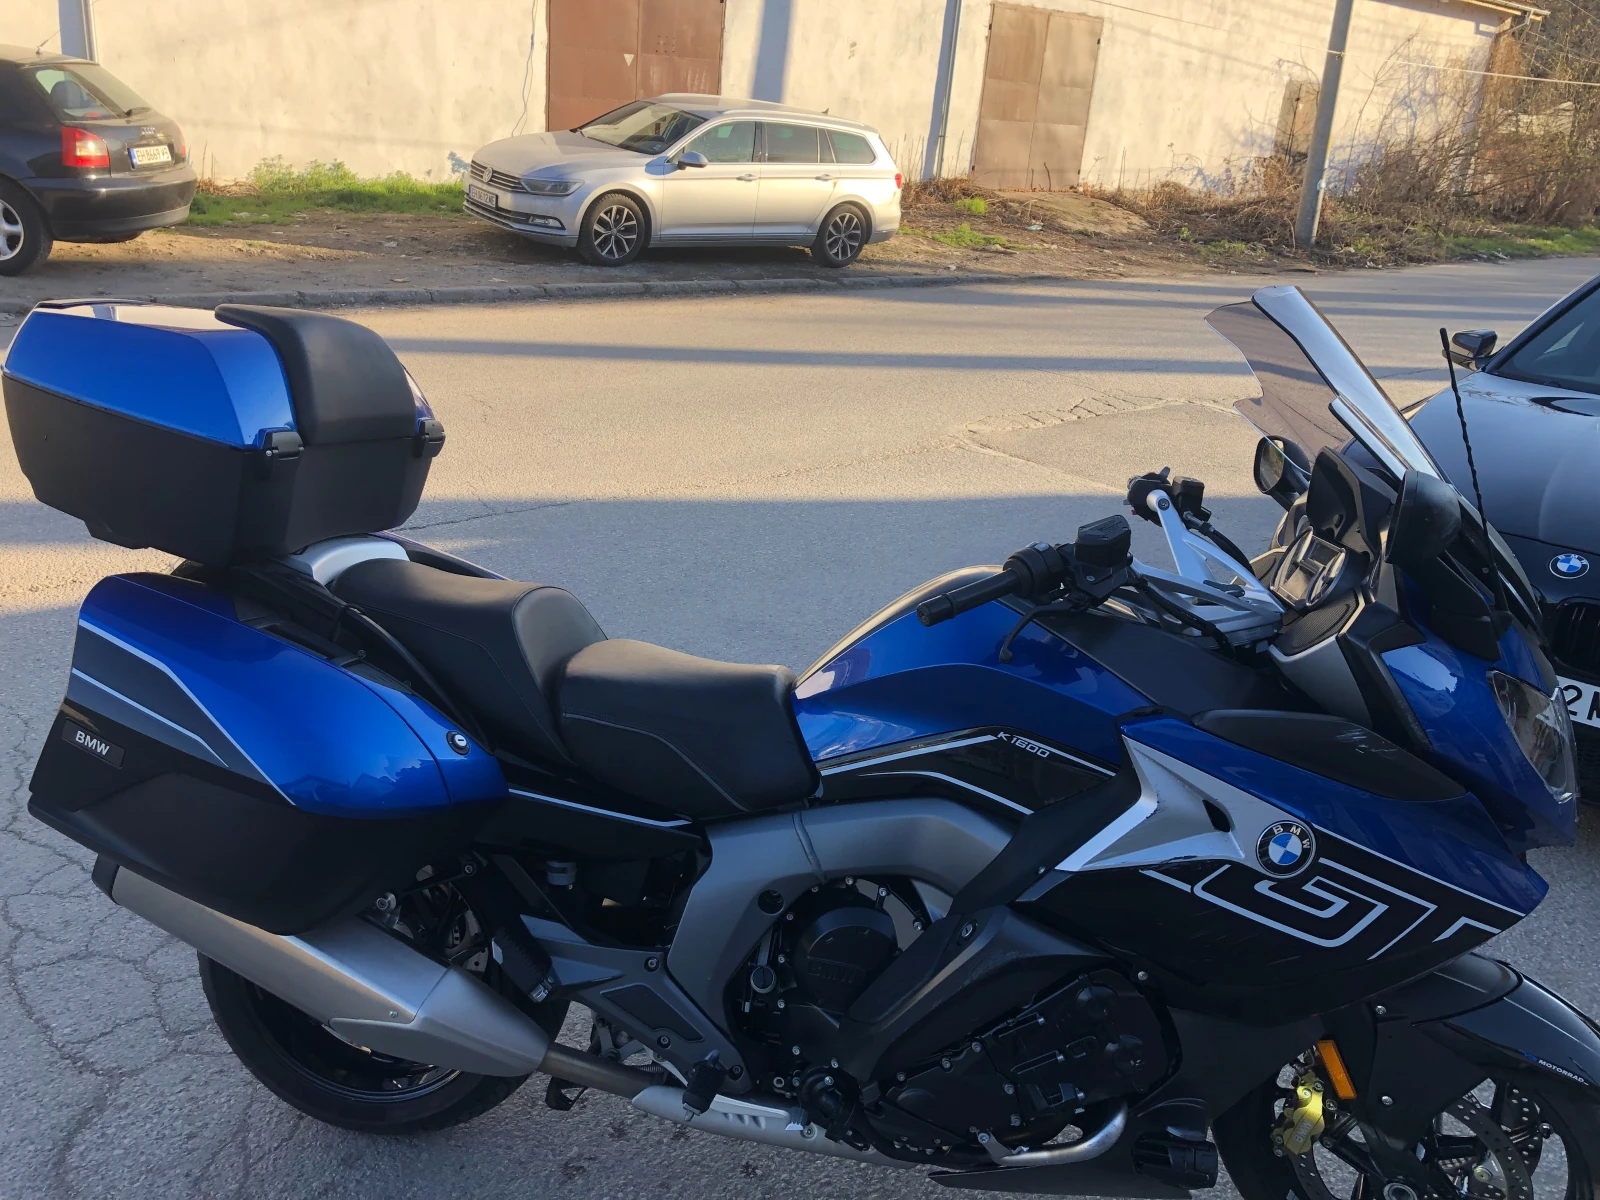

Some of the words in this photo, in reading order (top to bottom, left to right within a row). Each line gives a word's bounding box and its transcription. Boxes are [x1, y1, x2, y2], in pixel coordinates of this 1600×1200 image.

[75, 730, 110, 756] BMW
[997, 731, 1050, 758] K1600
[1272, 824, 1311, 849] BMW
[1538, 1059, 1585, 1083] MOTORRAD
